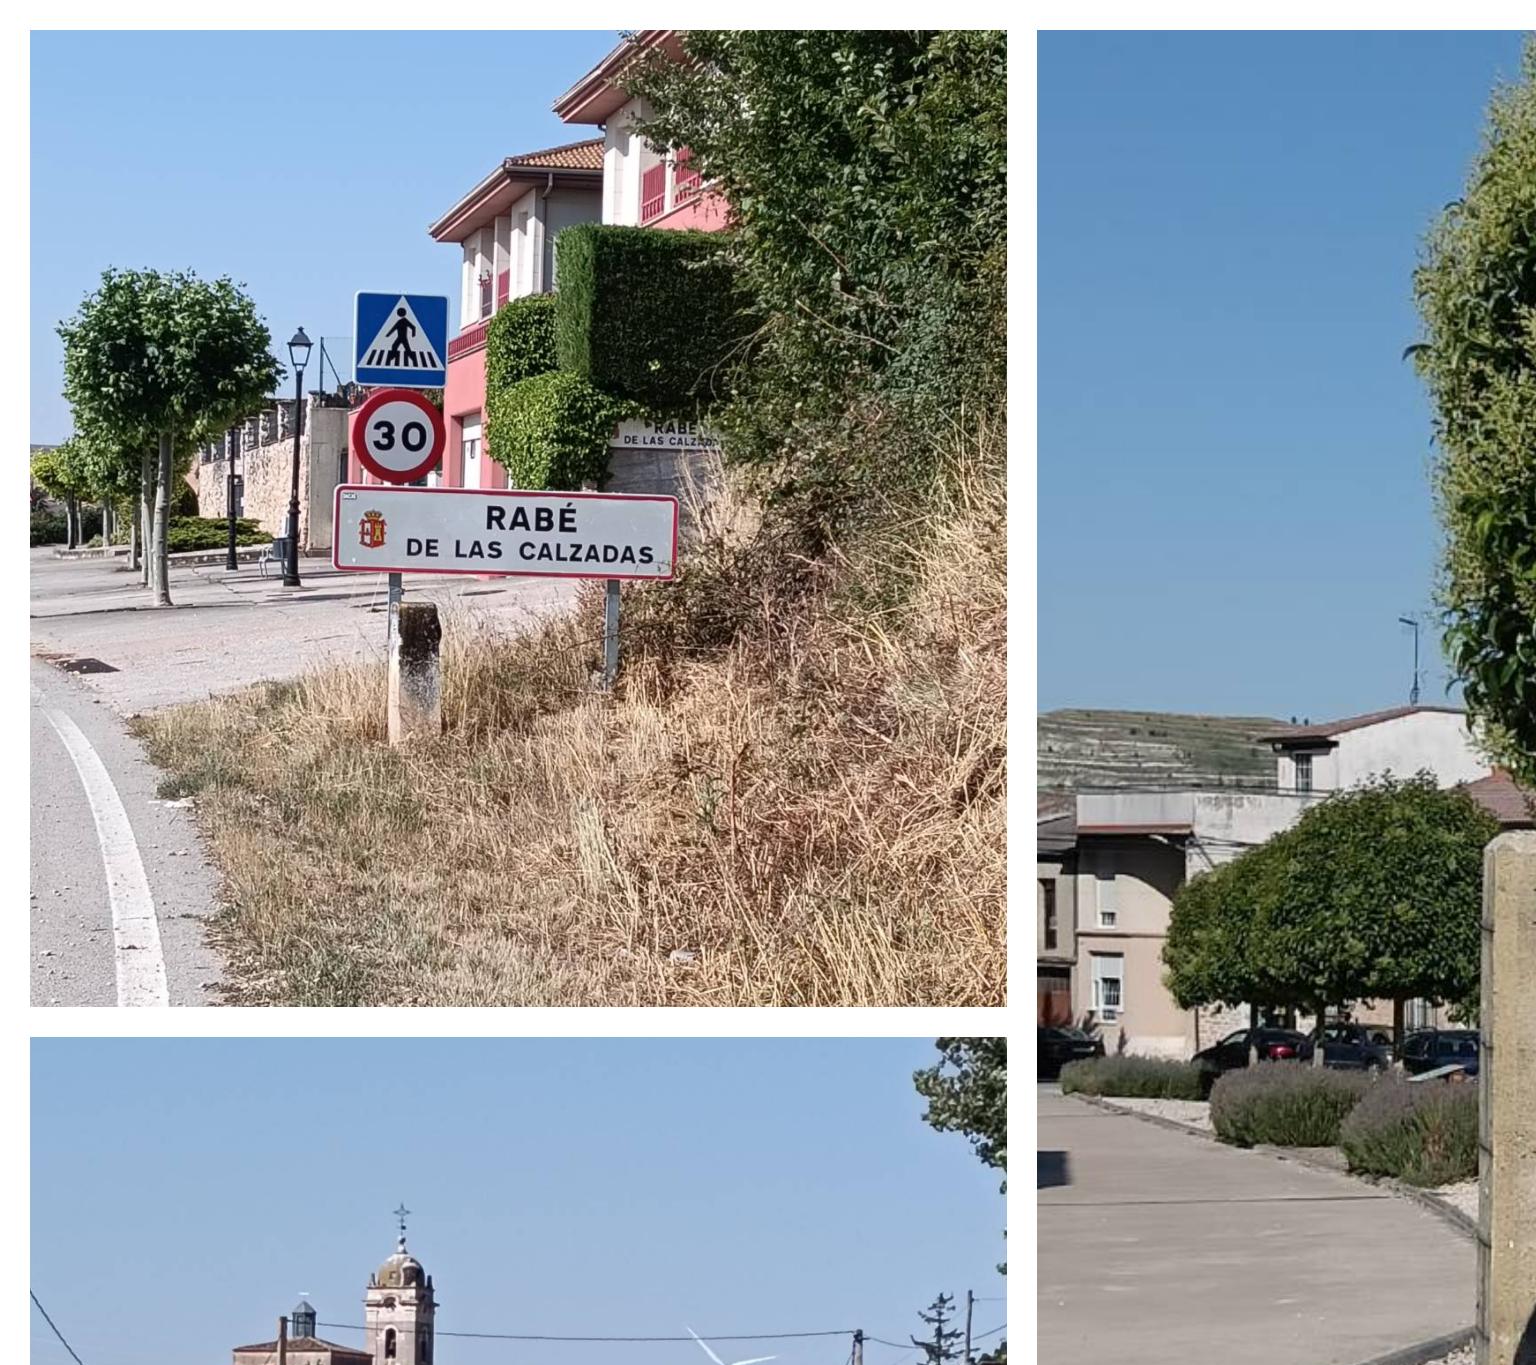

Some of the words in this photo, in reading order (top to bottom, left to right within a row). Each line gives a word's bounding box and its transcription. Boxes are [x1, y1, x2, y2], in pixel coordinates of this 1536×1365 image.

[373, 420, 427, 452] 30
[624, 435, 638, 445] DE
[642, 436, 664, 446] LAS
[486, 502, 578, 533] RABÉ
[406, 538, 439, 558] DE
[455, 539, 503, 560] LAS
[519, 541, 654, 565] CALZADAS
